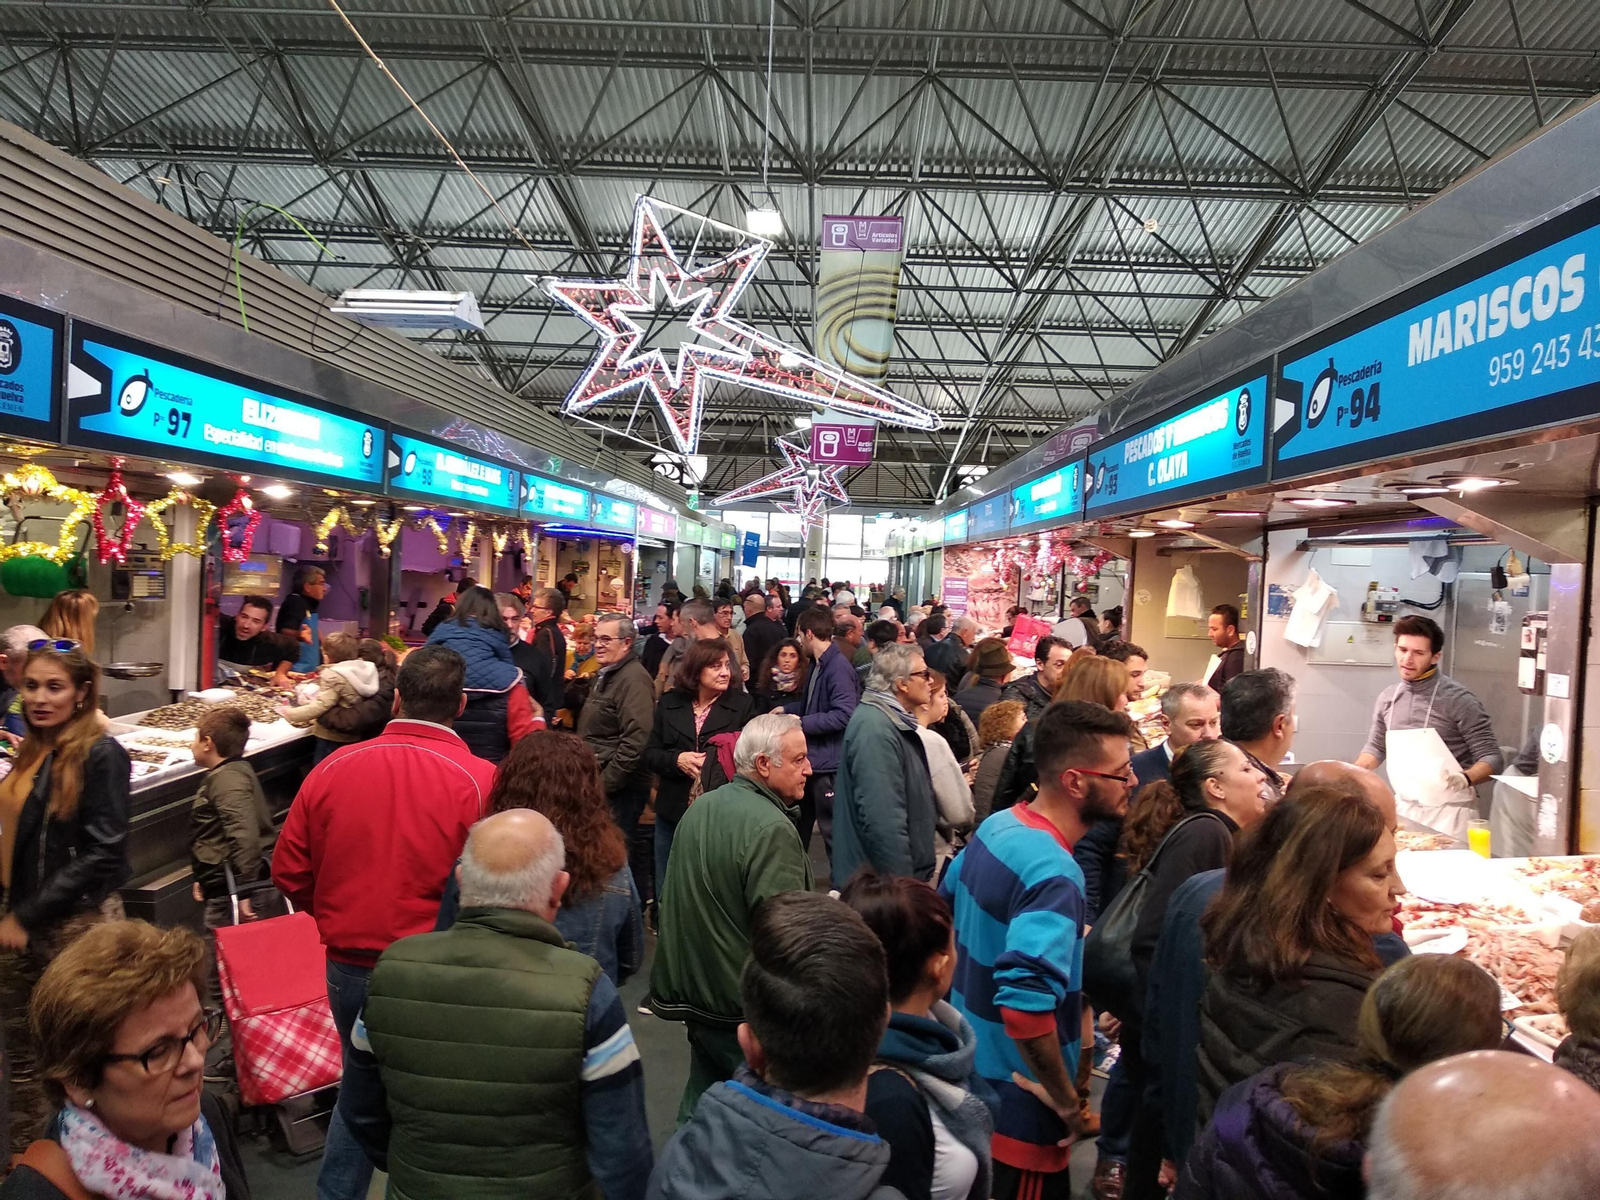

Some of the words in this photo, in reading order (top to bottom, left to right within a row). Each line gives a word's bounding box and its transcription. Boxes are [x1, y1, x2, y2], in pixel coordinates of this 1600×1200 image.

[1408, 253, 1585, 367] MARISCOS
[1489, 348, 1525, 387] 959
[1531, 333, 1571, 375] 243
[1124, 426, 1166, 465] PESCADOS
[1157, 449, 1188, 484] OLAYA
